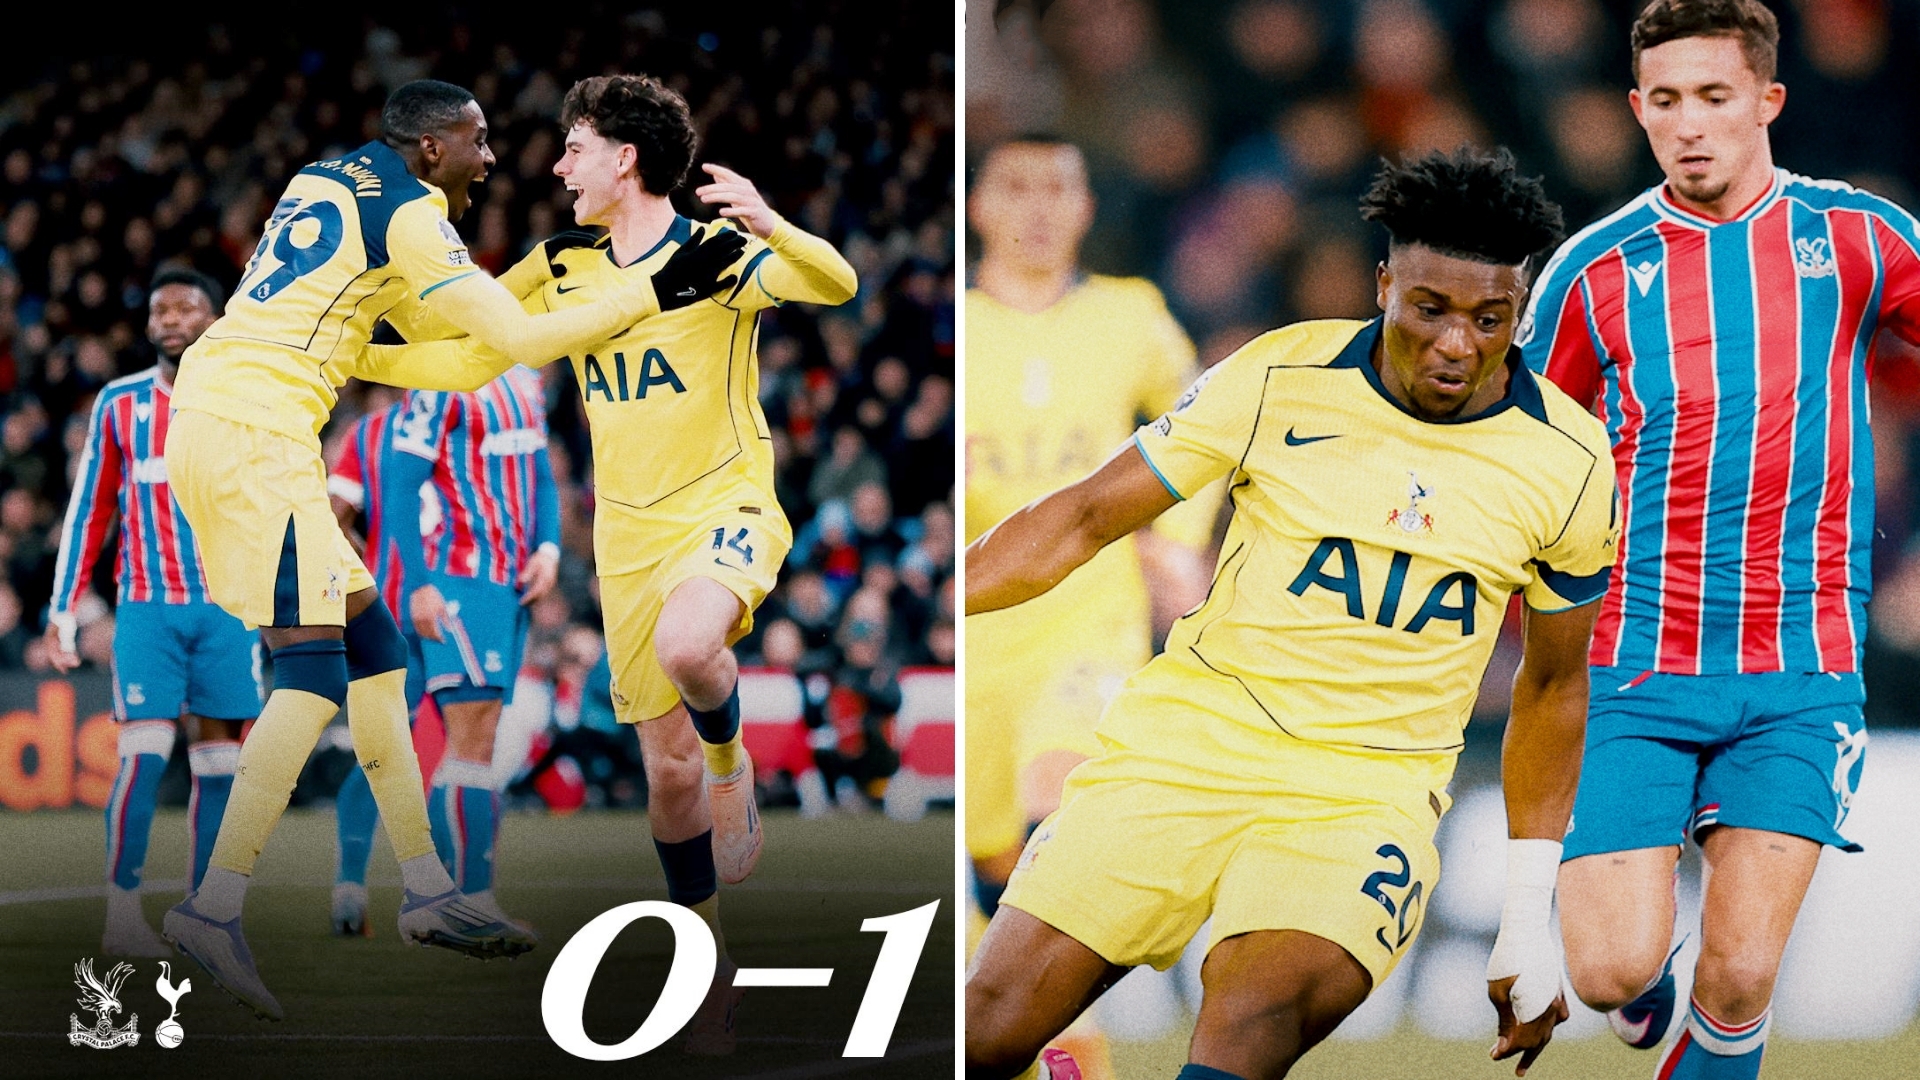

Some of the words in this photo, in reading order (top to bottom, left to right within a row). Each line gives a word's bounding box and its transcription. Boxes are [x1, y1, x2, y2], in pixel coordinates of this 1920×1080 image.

[585, 348, 687, 402] AIA
[711, 527, 753, 567] 14
[1287, 537, 1477, 636] AIA
[1360, 843, 1423, 949] 20
